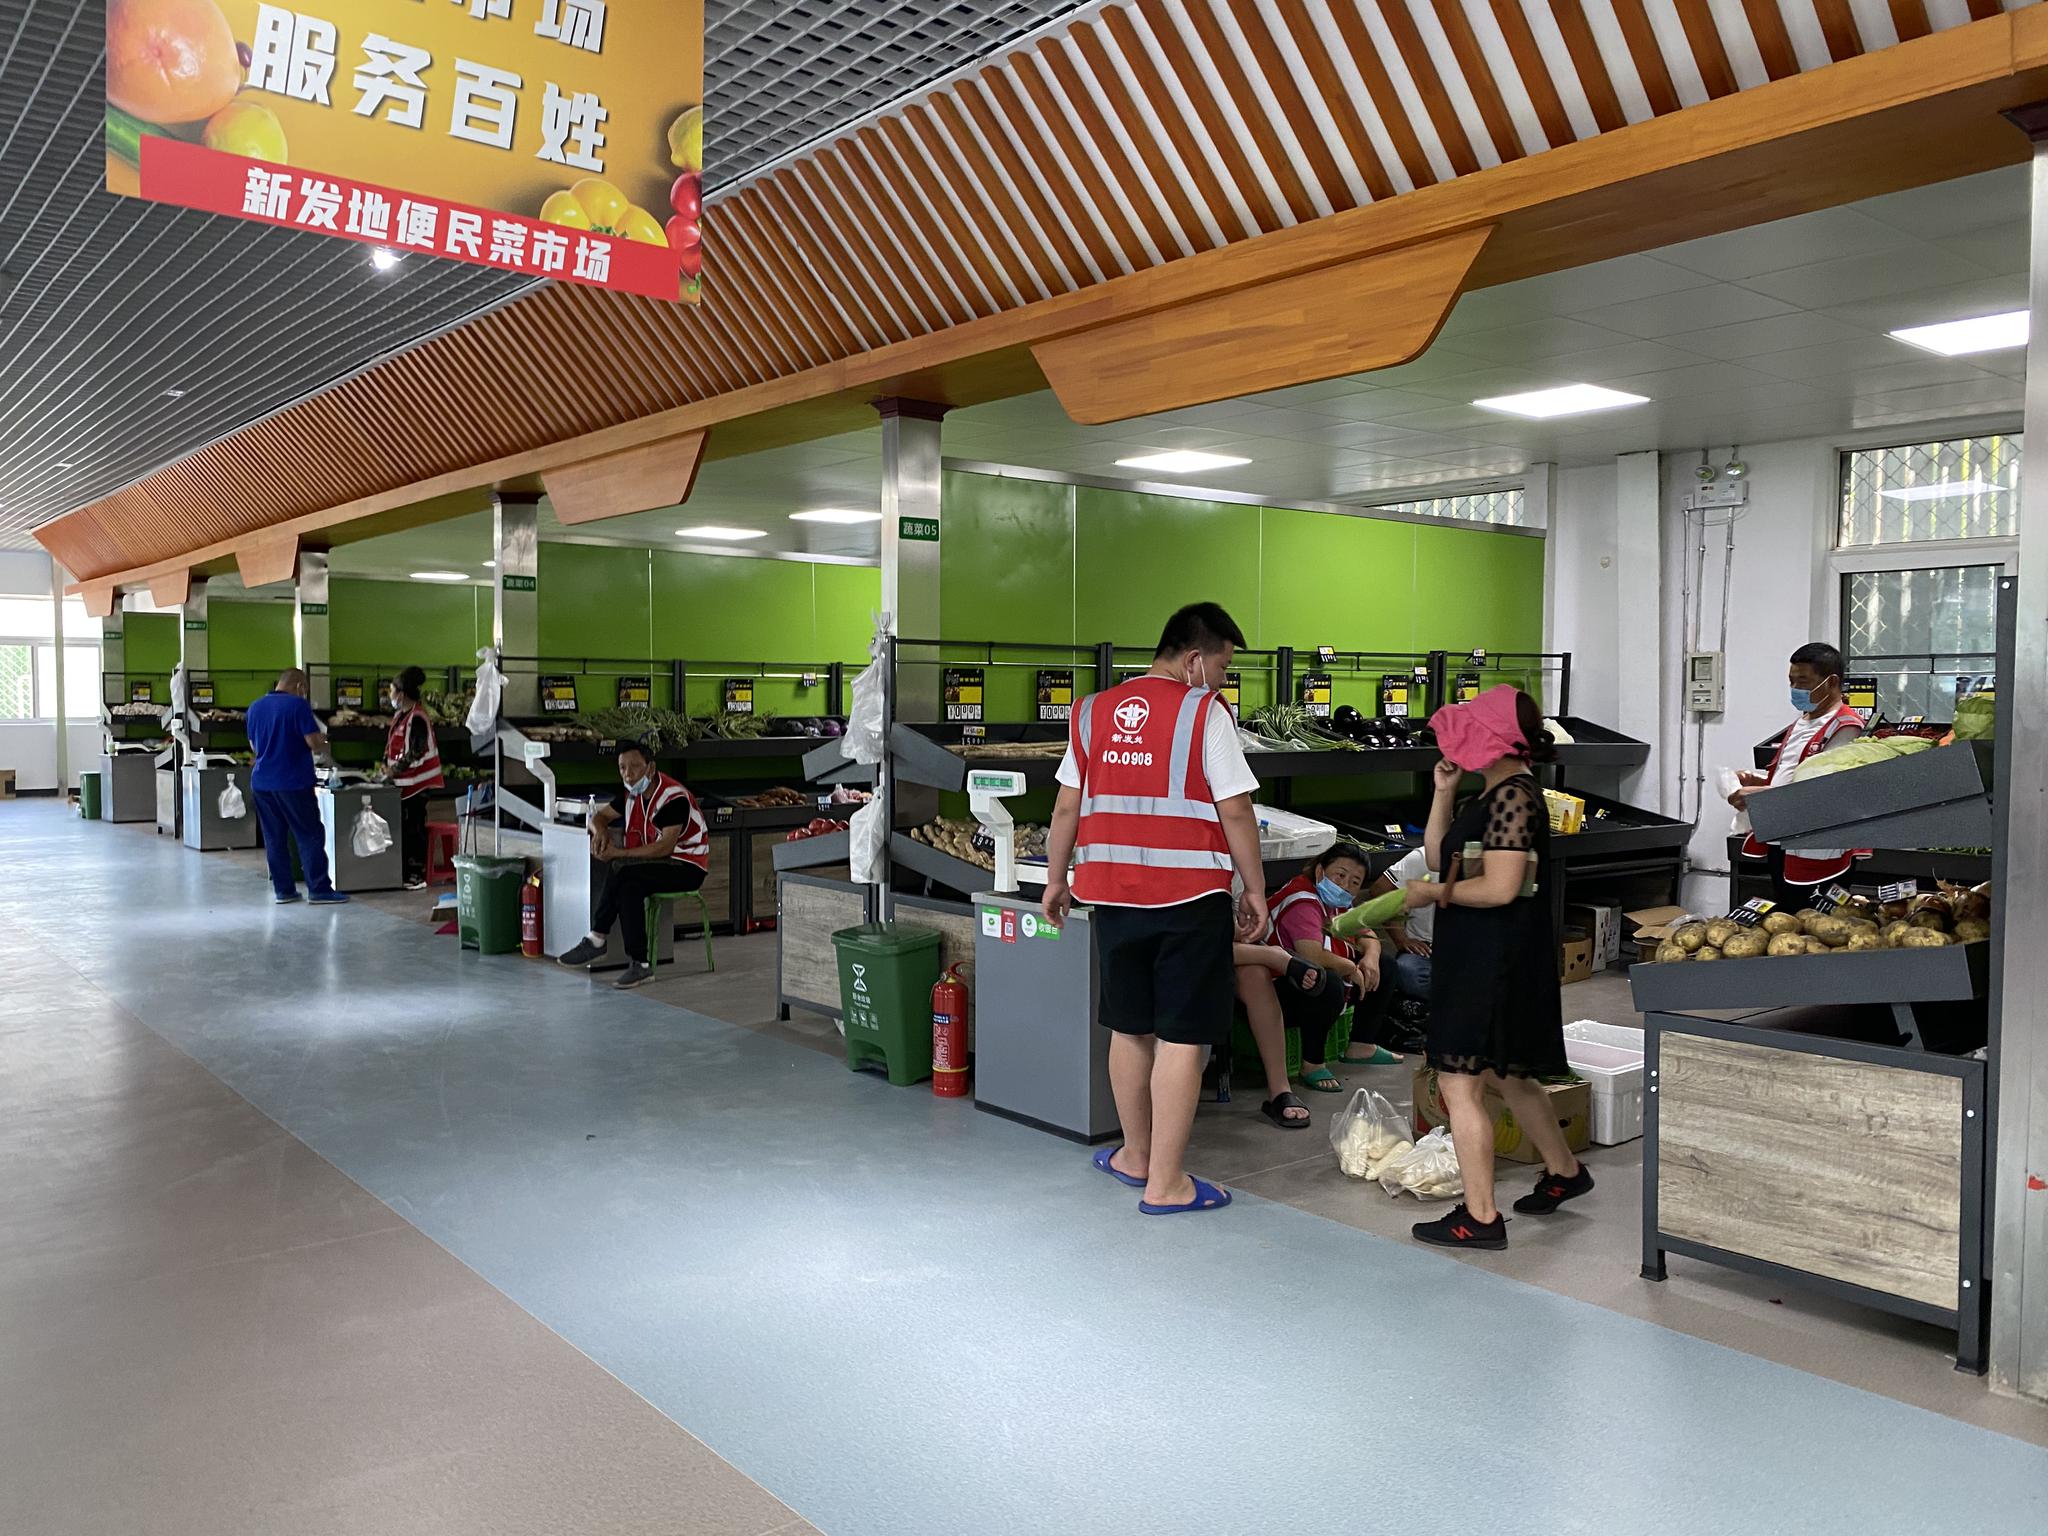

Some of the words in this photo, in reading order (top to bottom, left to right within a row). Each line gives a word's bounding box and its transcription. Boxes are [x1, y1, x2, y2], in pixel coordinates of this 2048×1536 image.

[246, 2, 608, 172] 服务百姓
[240, 167, 611, 282] 新发地便民菜市场
[903, 521, 937, 536] 蔬菜05
